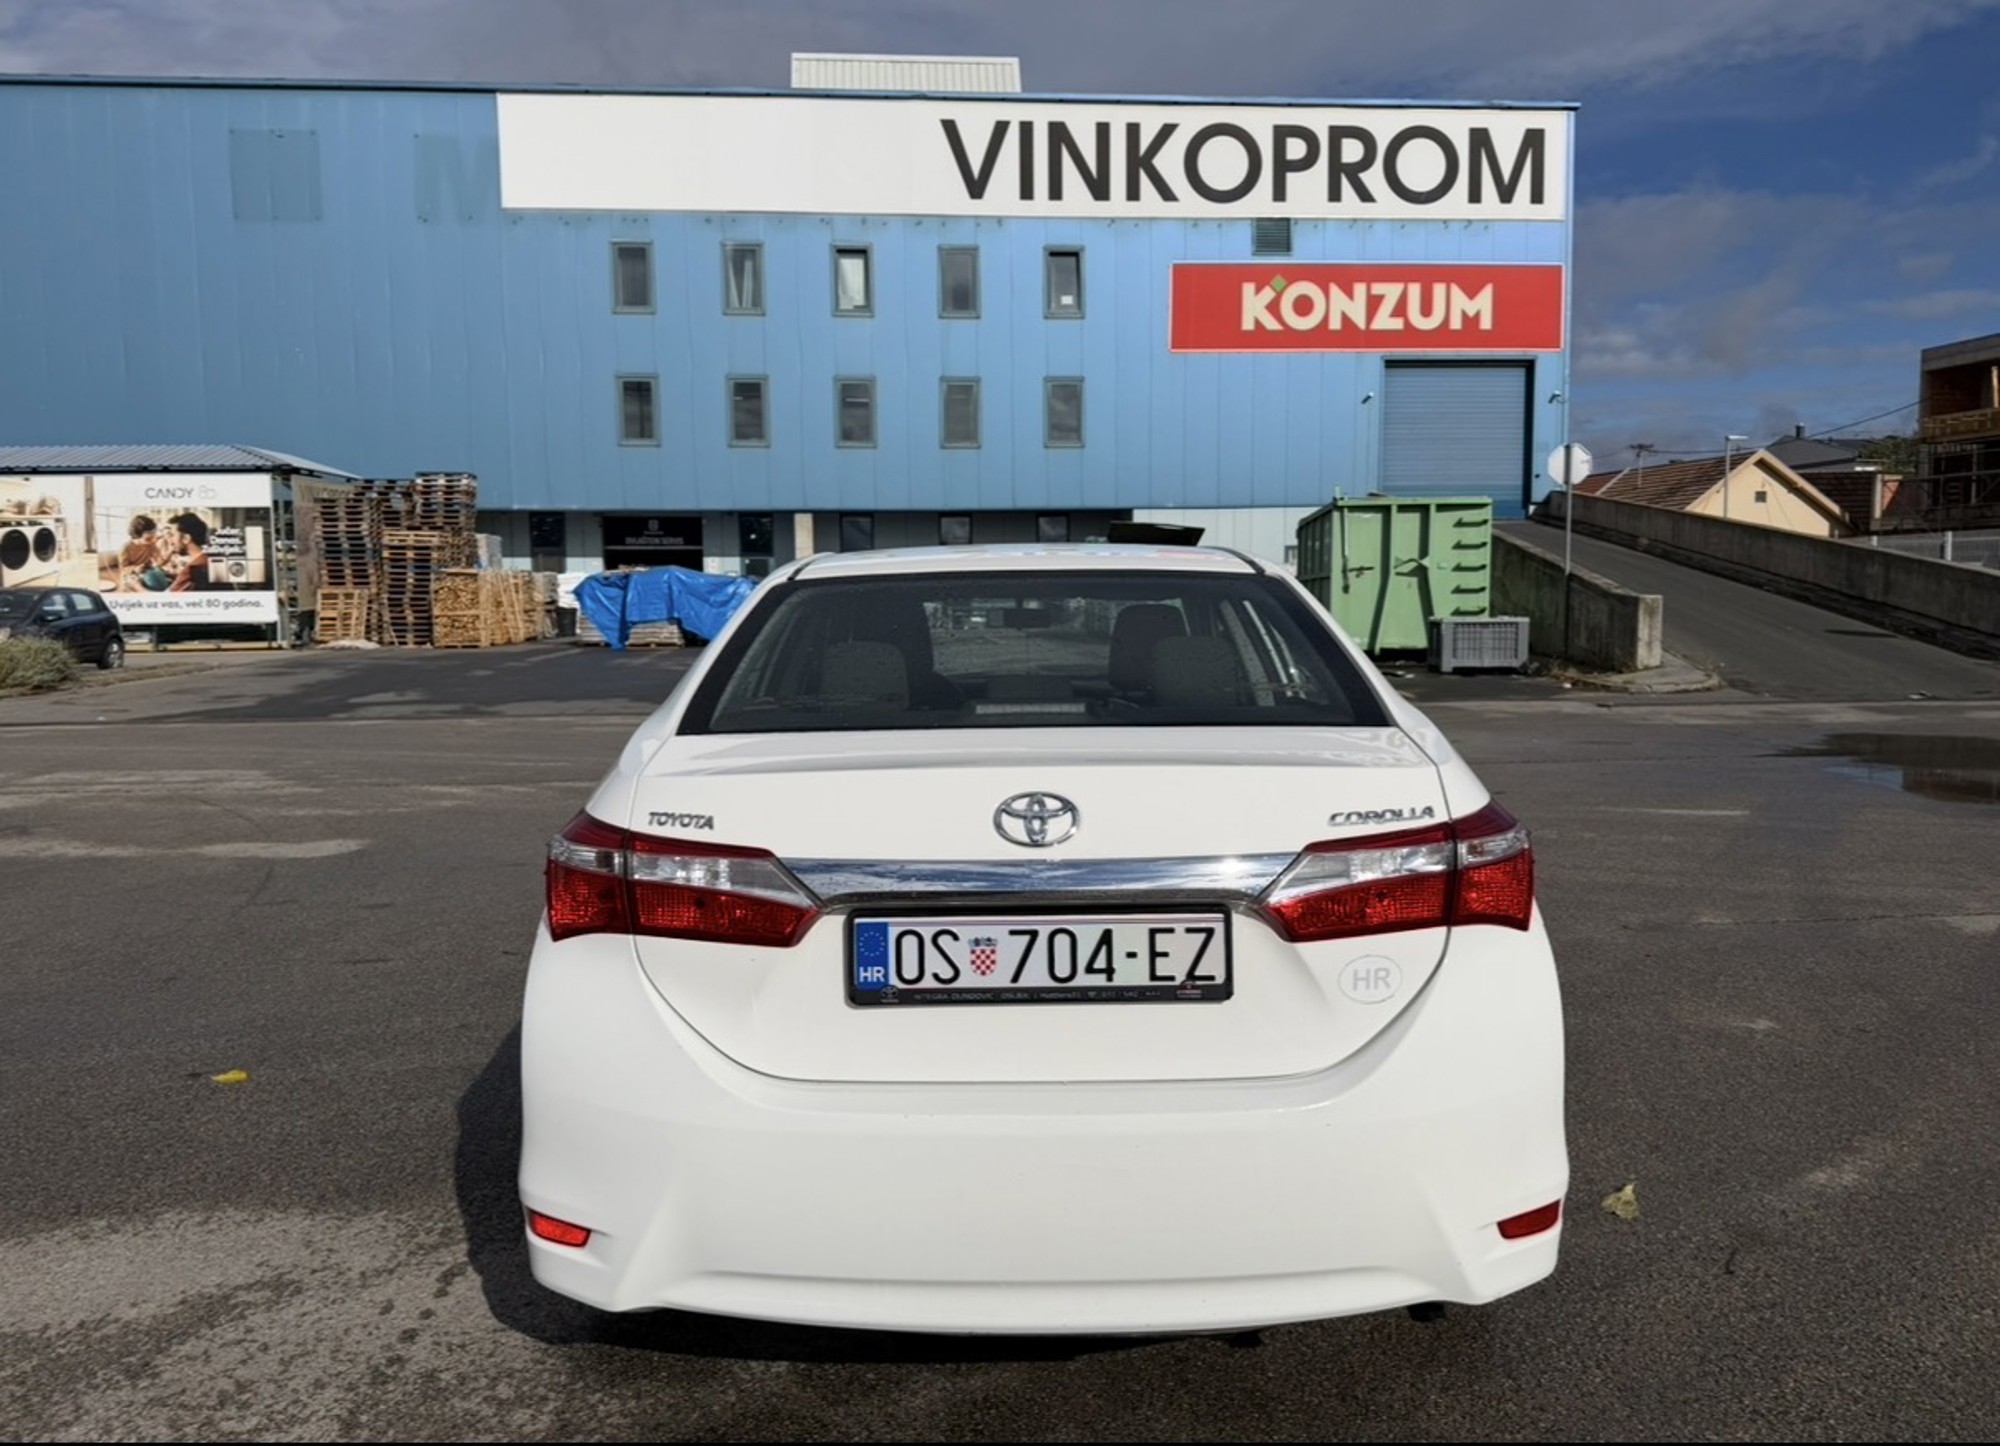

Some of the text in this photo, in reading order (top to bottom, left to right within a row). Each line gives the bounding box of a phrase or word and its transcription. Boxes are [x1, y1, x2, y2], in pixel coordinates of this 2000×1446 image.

[940, 118, 1546, 206] VINKOPROM
[1240, 277, 1493, 332] KONZUM
[144, 486, 194, 499] CANDY
[109, 600, 143, 611] Uvijek
[205, 598, 221, 608] 80
[648, 812, 715, 830] TOYOTA
[1327, 805, 1436, 827] COROLLA
[895, 927, 1217, 986] OS 704-EZ
[859, 966, 885, 983] HR
[1353, 968, 1392, 991] HR
